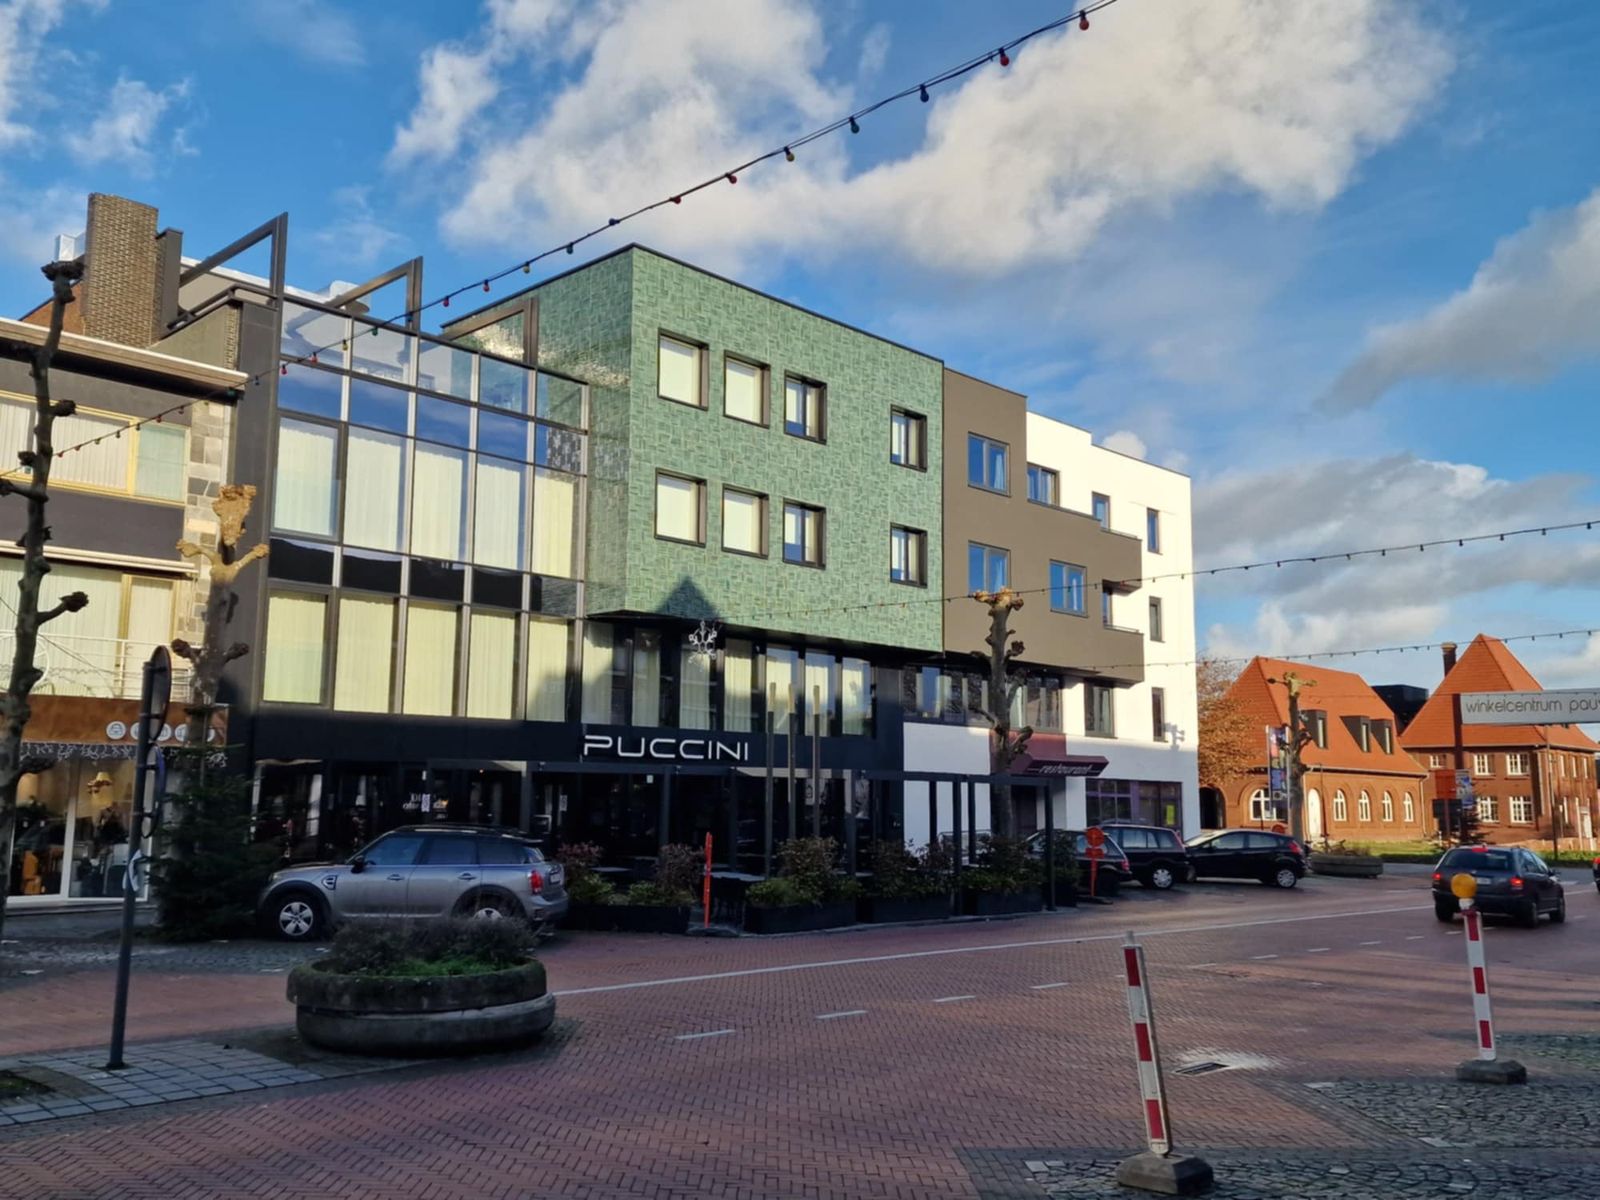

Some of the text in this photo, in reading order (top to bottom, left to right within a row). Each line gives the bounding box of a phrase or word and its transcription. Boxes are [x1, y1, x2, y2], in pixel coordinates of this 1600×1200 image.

[1467, 699, 1600, 714] winkelcentrum pau
[584, 735, 749, 761] PUCCINI
